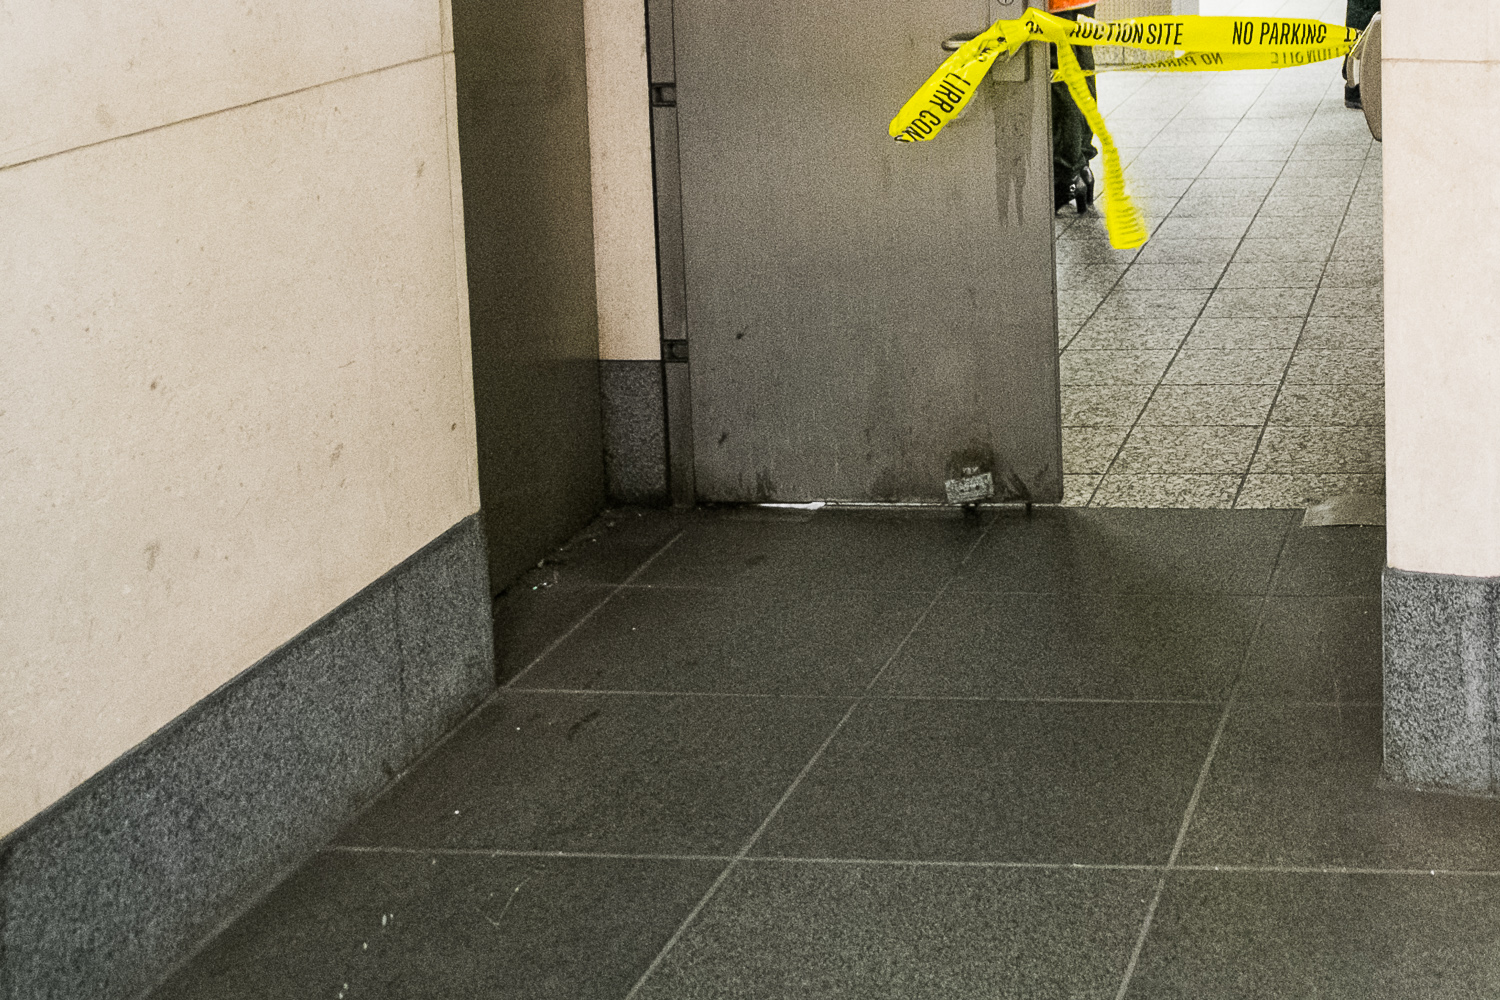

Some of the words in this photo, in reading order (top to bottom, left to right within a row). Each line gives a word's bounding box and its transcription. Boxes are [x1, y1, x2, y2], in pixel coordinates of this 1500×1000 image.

[1146, 23, 1184, 45] SITE
[1232, 21, 1254, 45] NO
[1259, 22, 1327, 45] PARKING
[929, 72, 971, 113] LIRR
